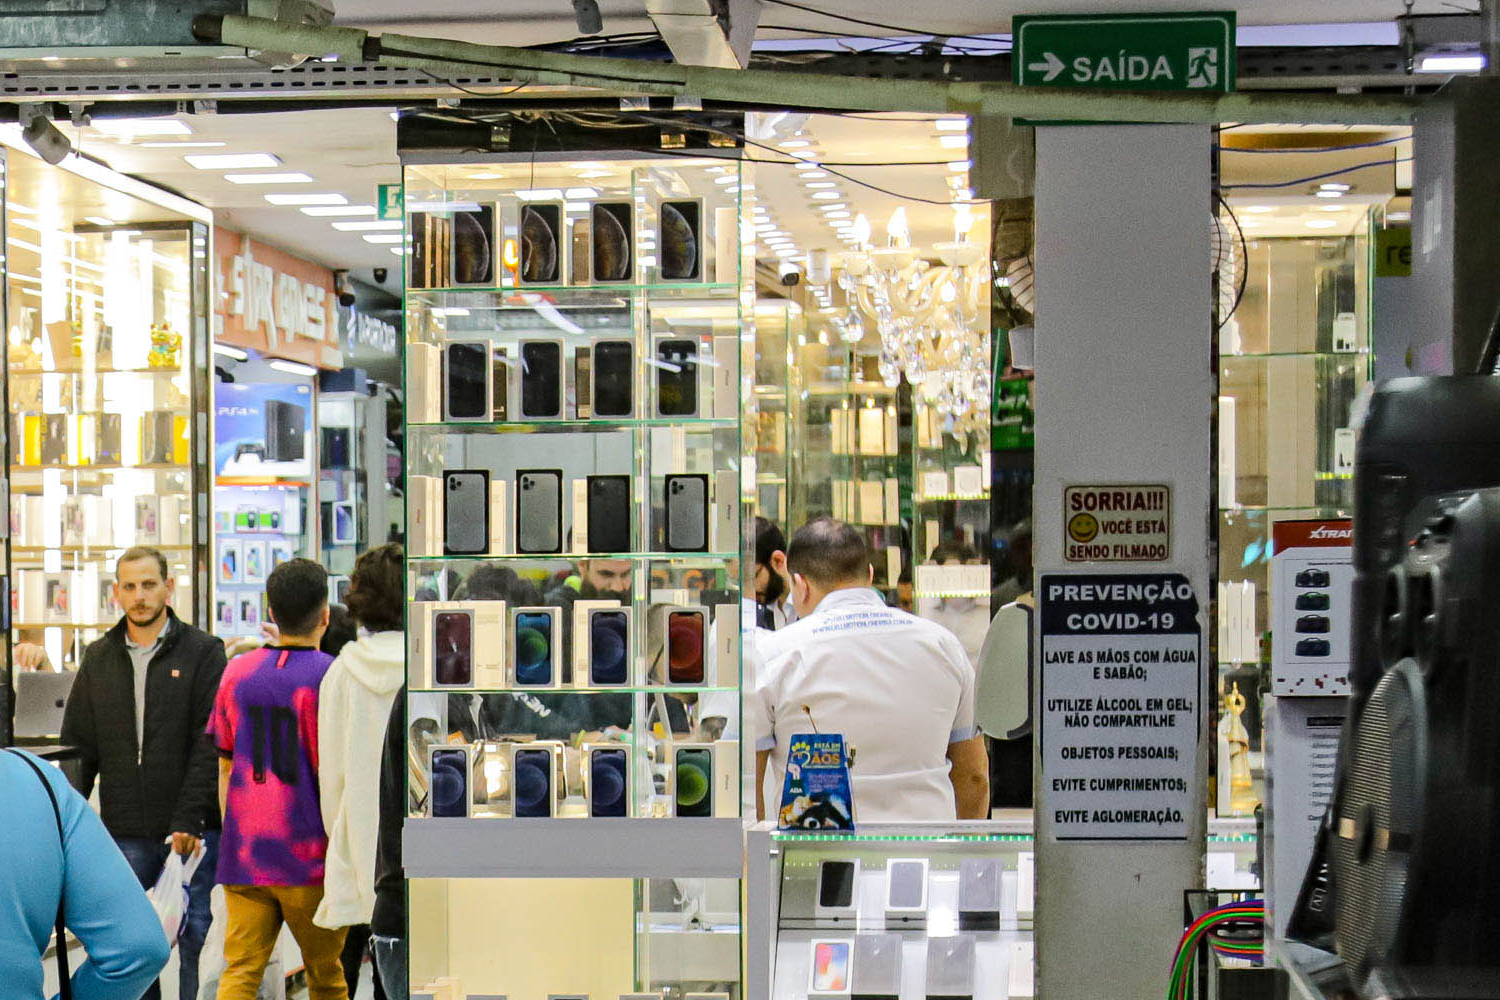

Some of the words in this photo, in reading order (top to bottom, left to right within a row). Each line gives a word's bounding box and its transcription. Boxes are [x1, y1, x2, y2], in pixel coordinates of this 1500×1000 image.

[1072, 49, 1174, 82] SAÍDA
[1070, 492, 1164, 512] SORRIA!!!
[1101, 518, 1132, 534] VOCÊ
[1136, 518, 1166, 534] ESTÁ
[1069, 545, 1110, 559] SENDO
[1113, 545, 1166, 559] FILMADO
[1049, 580, 1192, 605] PREVENÇÃO
[1066, 613, 1175, 630] COVID-19
[1045, 651, 1074, 664] LAVE
[1078, 651, 1093, 663] AS
[1096, 648, 1130, 663] MÃOS
[1134, 651, 1160, 663] COM
[1163, 648, 1196, 663] ÁGUA
[1093, 667, 1101, 680] E
[1104, 664, 1148, 682] SABÃO;
[1048, 699, 1093, 712] UTILIZE
[1096, 695, 1142, 712] ÁLCOOL
[1146, 699, 1163, 711] EM
[1167, 698, 1193, 713] GEL;
[1064, 712, 1089, 728] NÃO
[1093, 714, 1176, 728] COMPARTILHE
[248, 705, 299, 786] 10
[1061, 747, 1115, 760] OBJETOS
[1118, 746, 1179, 762] PESSOAIS;
[1052, 778, 1086, 791] EVITE
[1090, 778, 1187, 794] CUMPRIMENTOS;
[1055, 810, 1088, 823] EVITE
[1092, 807, 1184, 826] AGLOMERAÇÃO.
